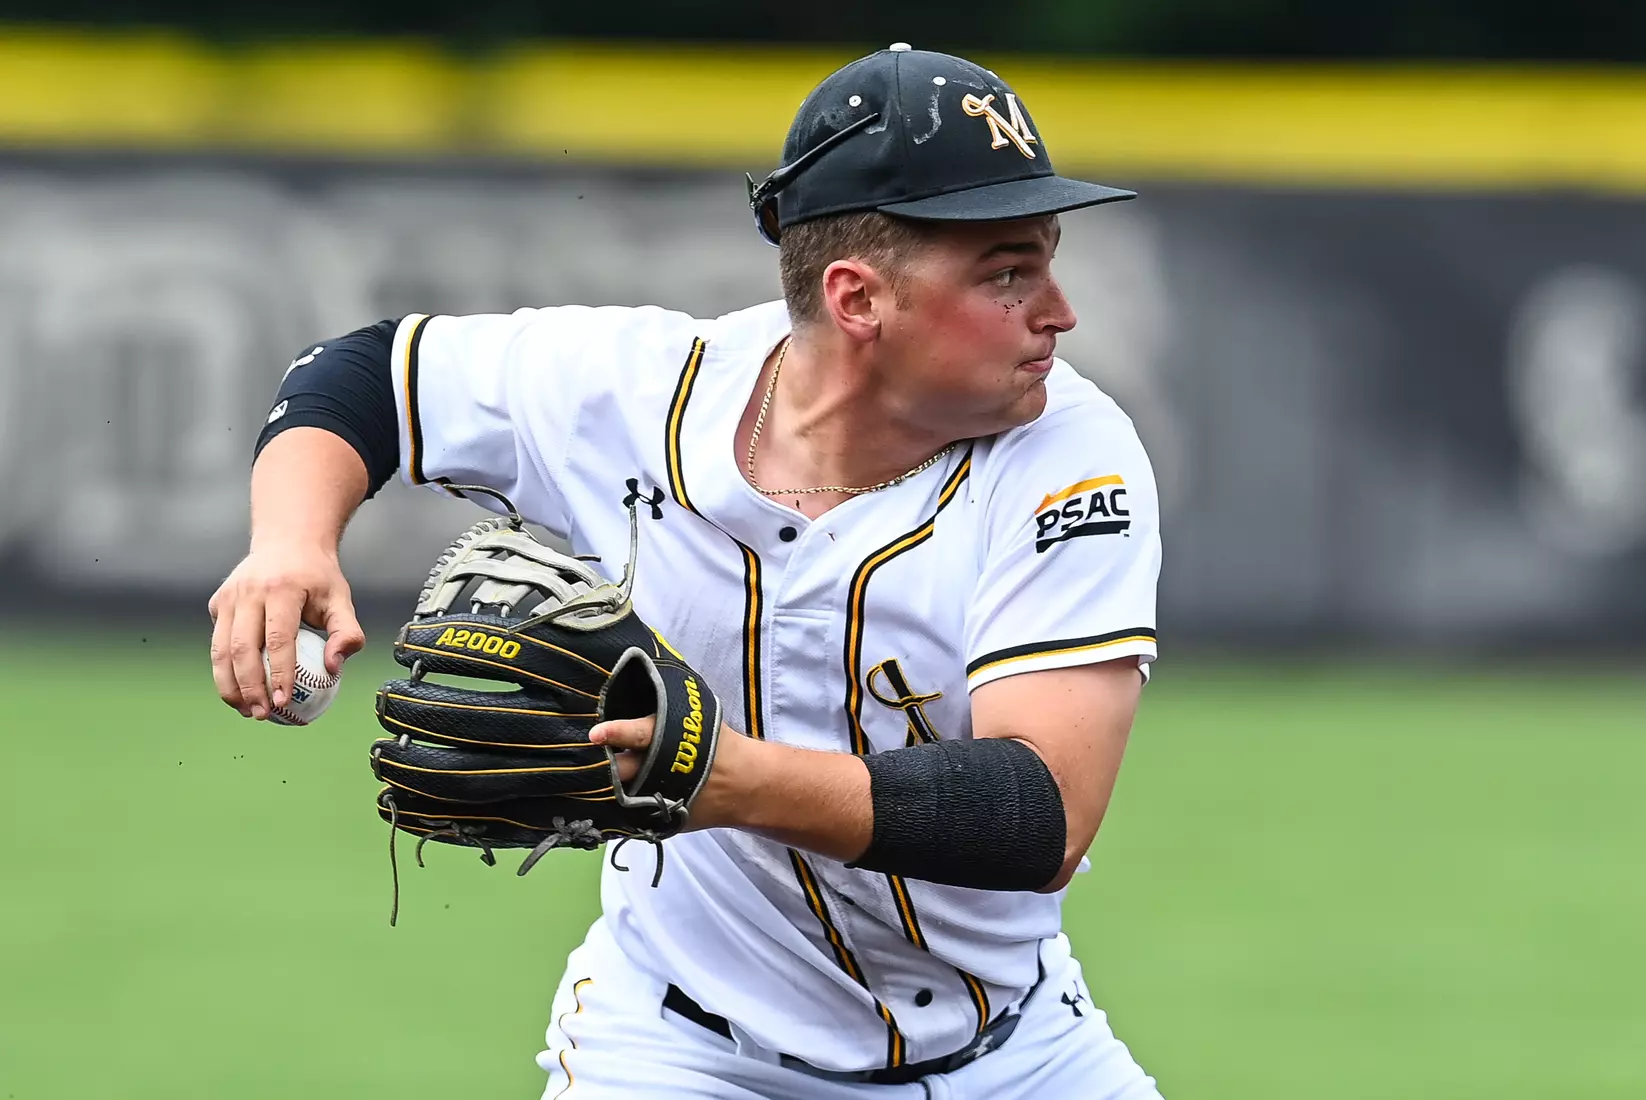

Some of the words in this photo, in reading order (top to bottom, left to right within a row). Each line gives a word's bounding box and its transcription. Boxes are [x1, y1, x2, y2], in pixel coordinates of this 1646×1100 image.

[1036, 488, 1129, 539] PSAC
[435, 627, 521, 659] A2000
[670, 677, 703, 774] Wilson
